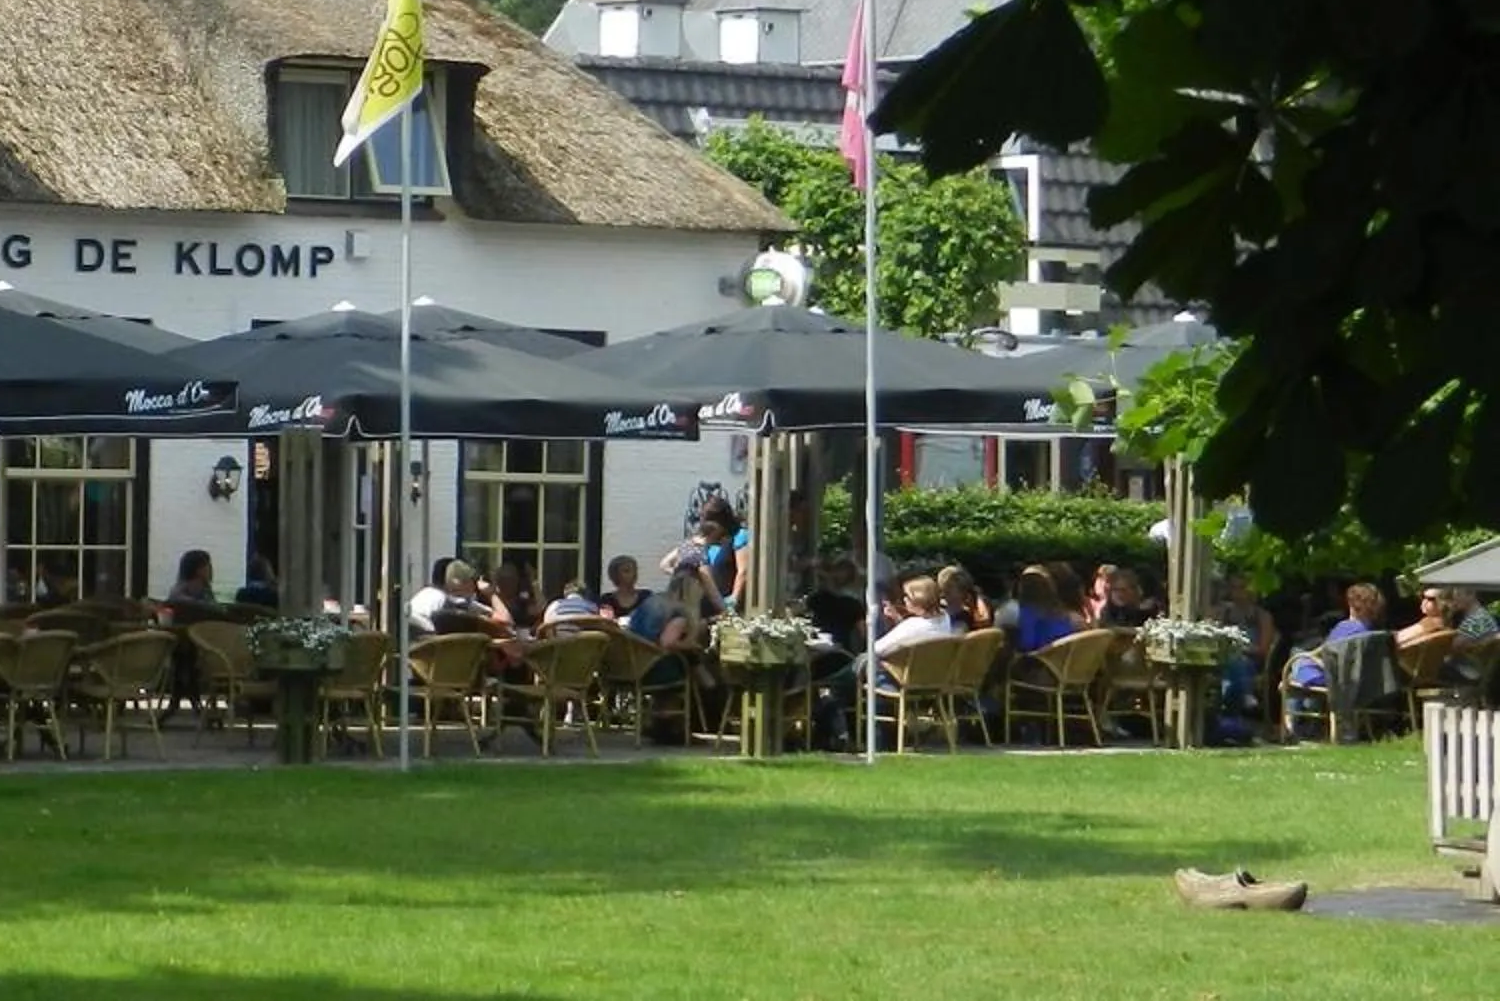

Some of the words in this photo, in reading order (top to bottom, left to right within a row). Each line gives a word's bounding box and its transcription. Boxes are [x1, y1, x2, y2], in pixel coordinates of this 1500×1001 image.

[75, 239, 137, 275] DE
[175, 241, 336, 280] KLOMP
[125, 389, 174, 413] Mocca
